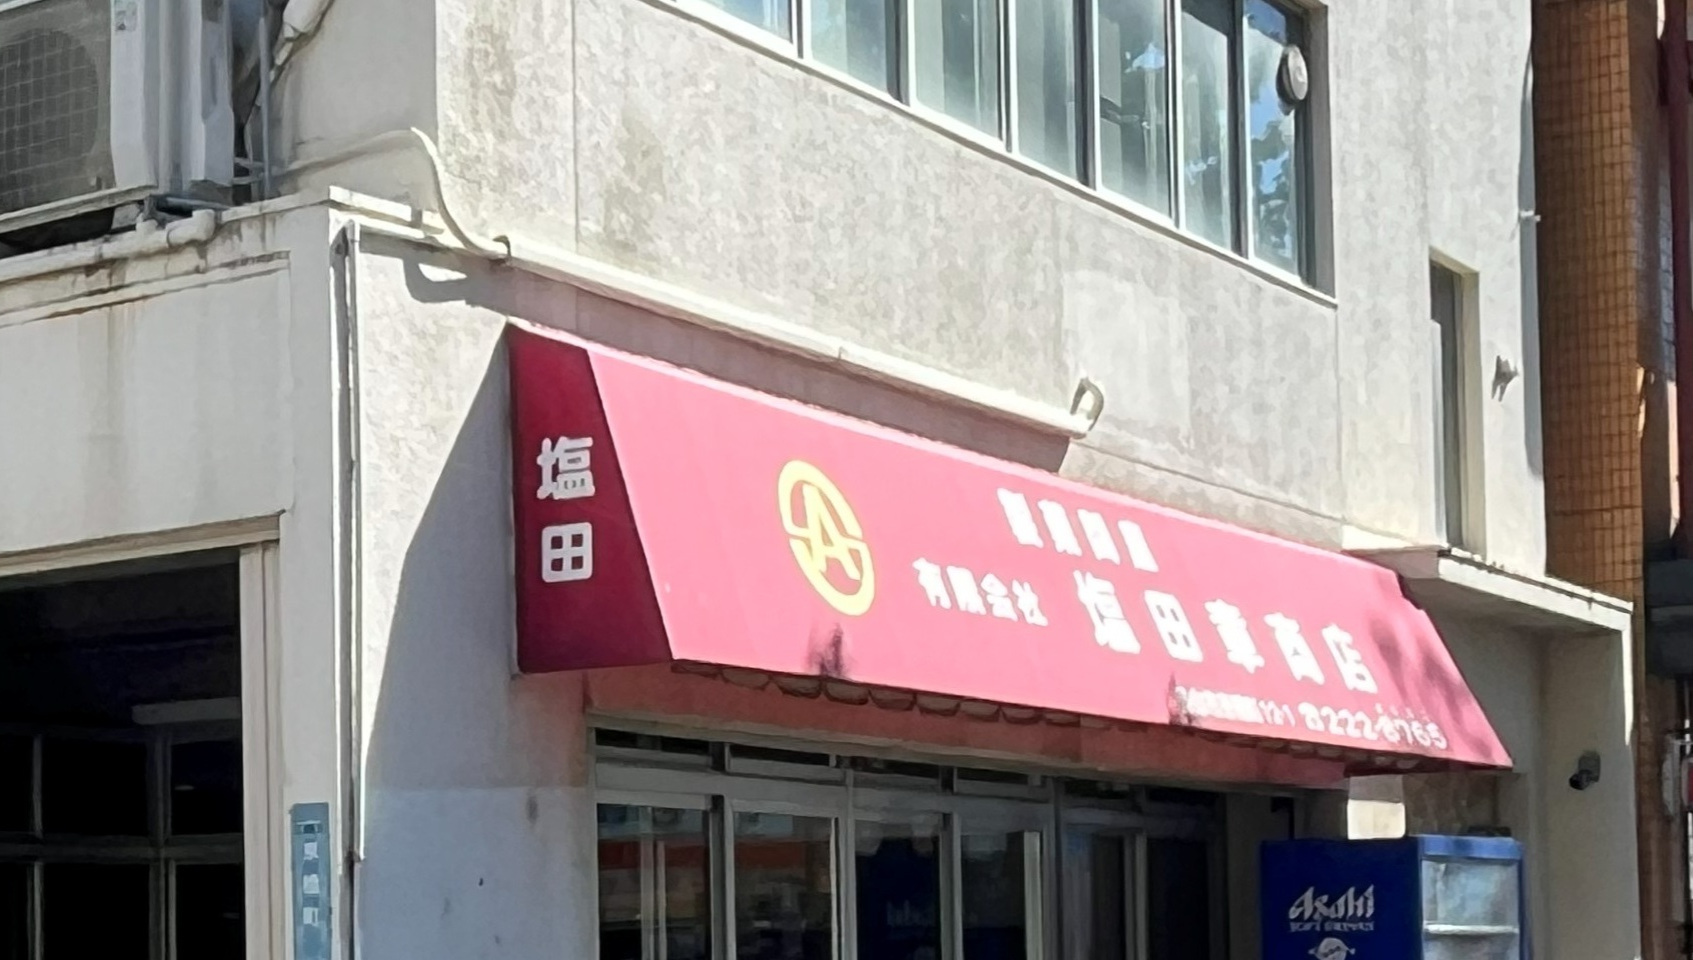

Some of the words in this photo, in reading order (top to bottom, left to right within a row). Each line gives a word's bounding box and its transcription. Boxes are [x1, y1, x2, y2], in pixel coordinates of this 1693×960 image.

[536, 435, 596, 584] 塩田
[911, 556, 1049, 627] 有限会社
[1288, 884, 1375, 921] Asahi
